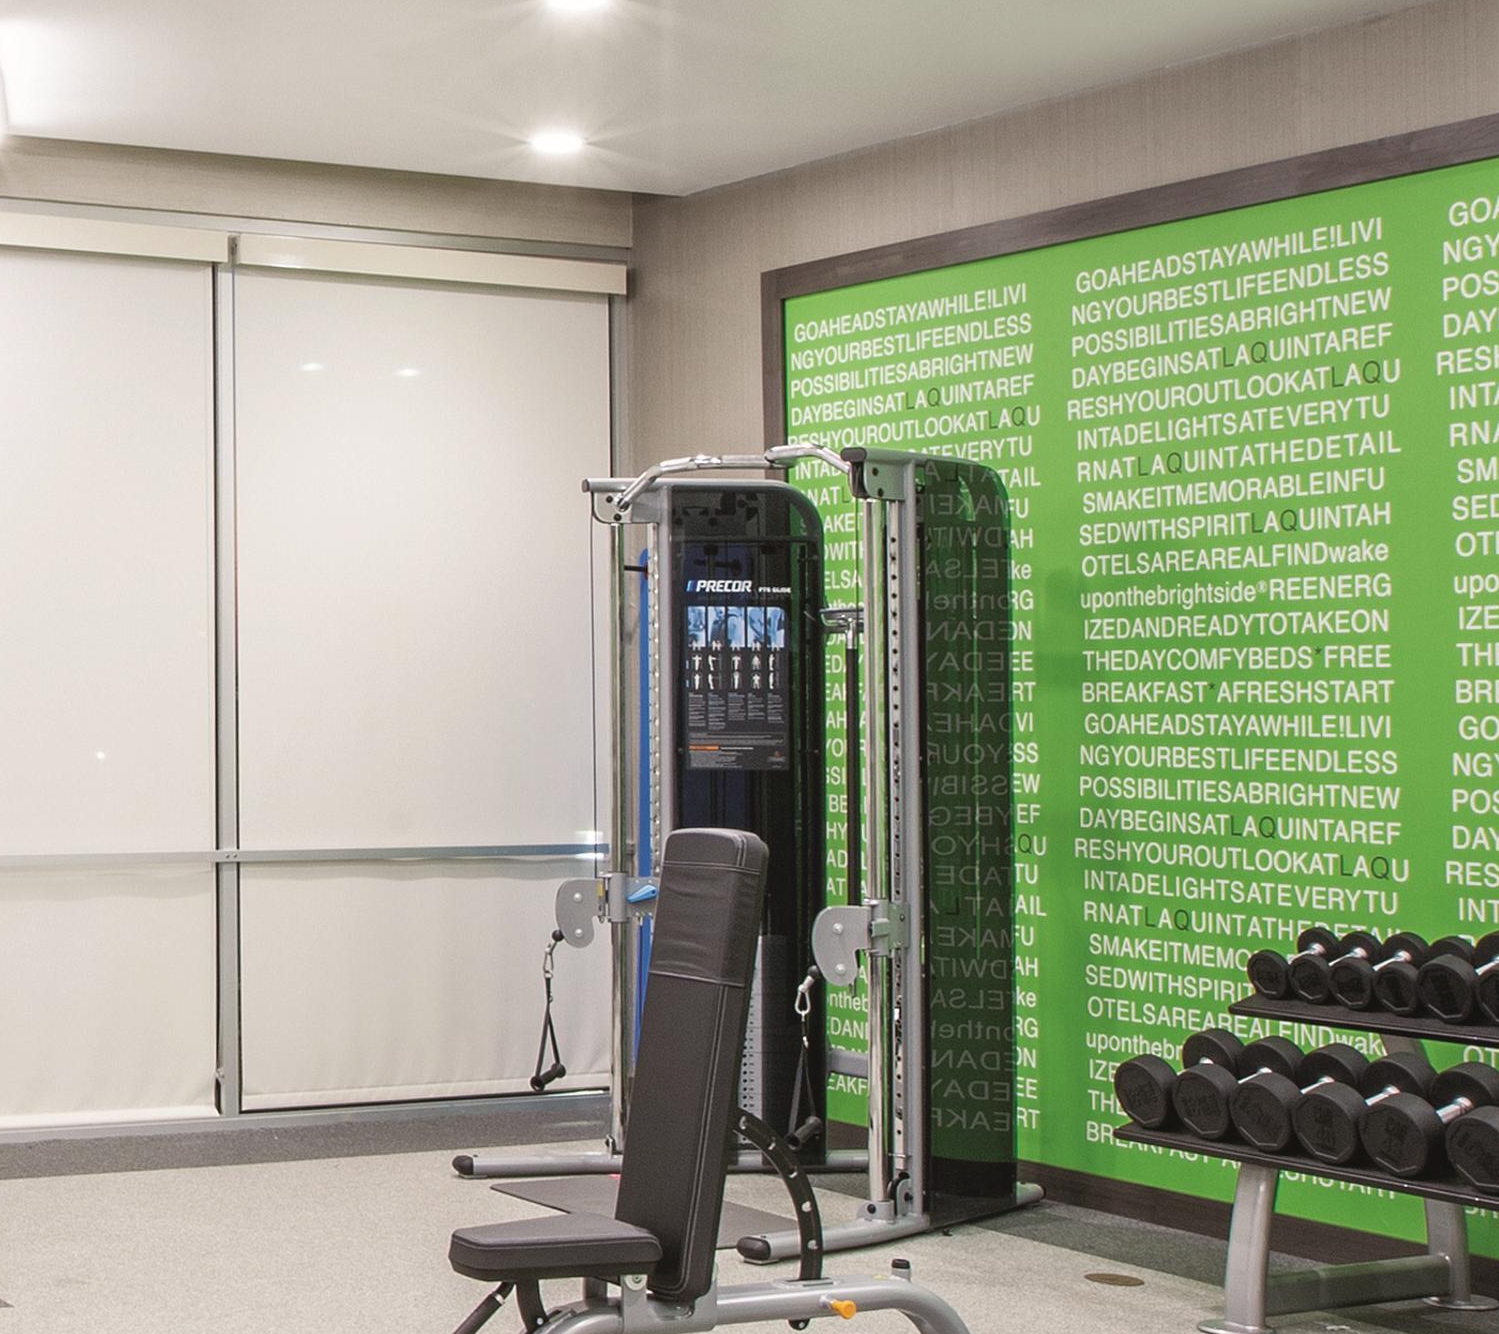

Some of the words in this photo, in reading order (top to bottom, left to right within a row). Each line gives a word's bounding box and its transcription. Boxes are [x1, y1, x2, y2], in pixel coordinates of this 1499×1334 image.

[1076, 218, 1381, 293] GOAHEADSTAYAWHILE!LIVI
[1072, 252, 1388, 325] NGYOURBESTLIFEENDLESS
[794, 283, 1026, 343] GOAHEADSTAYAWHILE!LIVI
[1072, 287, 1390, 357] POSSIBILITIESABRIGHTNEW
[791, 313, 1031, 371] NGYOURBESTLIFEENDLESS
[1072, 323, 1392, 389] DAYBEGINSATLAQUINTAREF
[791, 344, 1033, 399] POSSIBILITIESABRIGHTNEW
[1068, 358, 1400, 420] RESHYOUROUTLOOKATLAQU
[791, 374, 1034, 427] DAYBEGINSATLAQUINTAREF
[1078, 394, 1389, 450] INTADELIGHTSATEVERYTU
[1078, 431, 1400, 482] RNATLAQUINTATHEDETAIL
[1084, 467, 1384, 513] SMAKEITMEMORABLEINFU
[1080, 502, 1390, 545] SEDWITHSPIRITLAQUINTAH
[1082, 539, 1388, 577] OTELSAREAREALFINDwake
[696, 580, 752, 593] PRECOR
[1085, 609, 1388, 639] IZEDANDREADYTOTAKEON
[1085, 713, 1390, 738] GOAHEADSTAYAWHILE!LIVI
[1081, 745, 1397, 774] NGYOURBESTLIFEENDLESS
[1080, 776, 1399, 809] POSSIBILITIESABRIGHTNEW
[1080, 808, 1400, 845] DAYBEGINSATLAQUINTAREF
[1075, 838, 1409, 882] RESHYOUROUTLOOKATLAQU
[1085, 870, 1397, 915] INTADELIGHTSATEVERYTU
